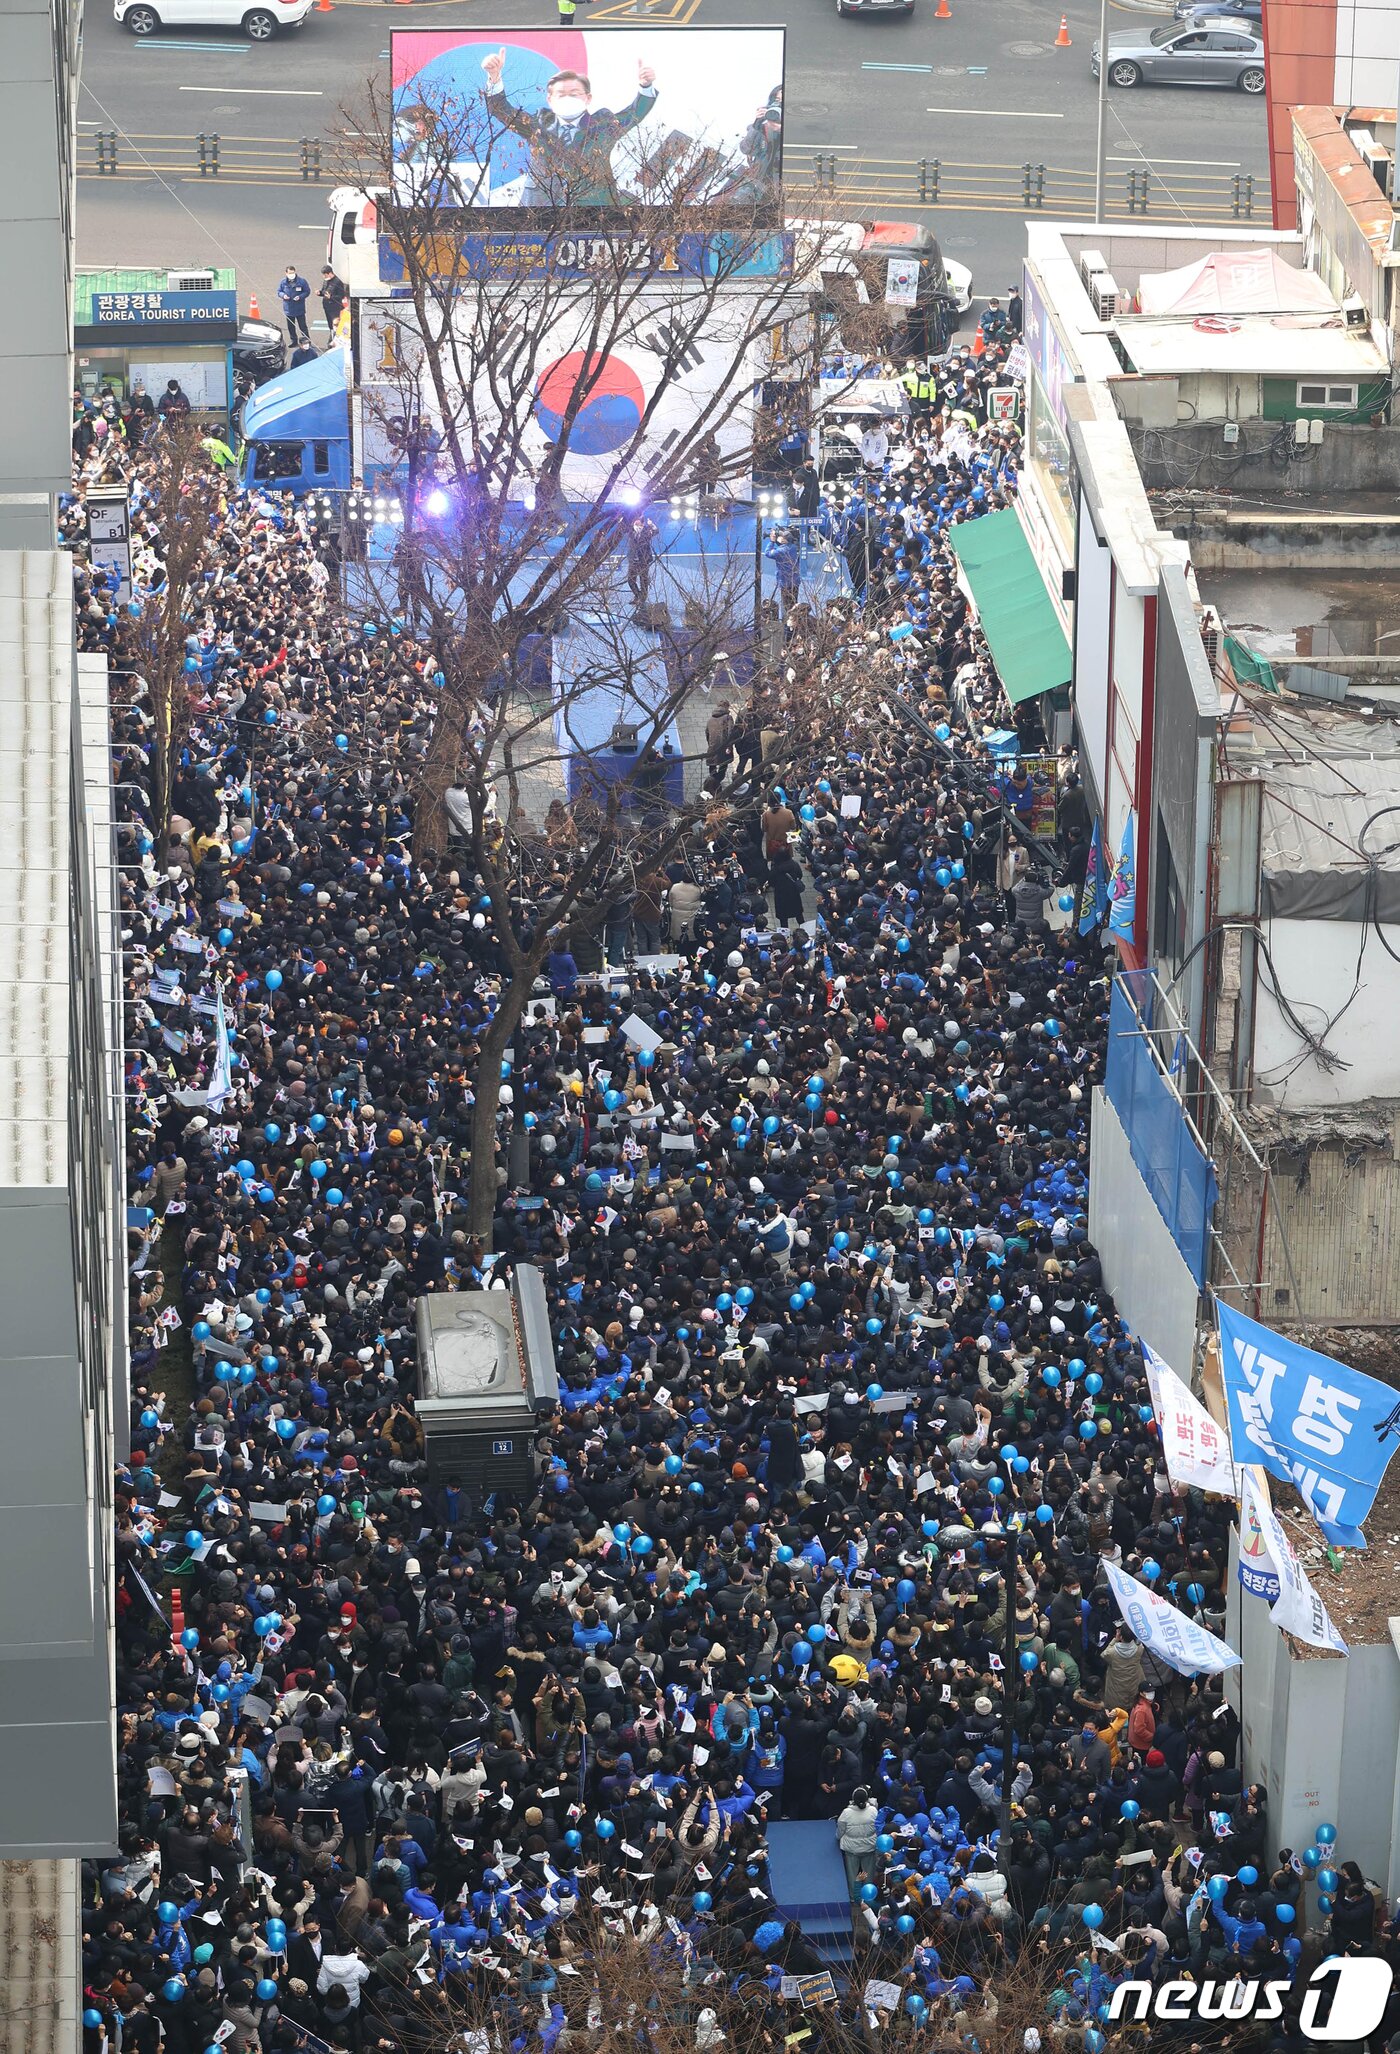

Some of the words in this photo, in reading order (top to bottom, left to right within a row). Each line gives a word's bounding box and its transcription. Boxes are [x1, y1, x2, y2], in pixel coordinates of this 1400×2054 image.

[98, 294, 163, 309] 관광경찰
[99, 311, 135, 321] KOREA
[140, 309, 186, 320] TOURIST
[191, 307, 230, 319] POLICE
[109, 523, 126, 538] B1
